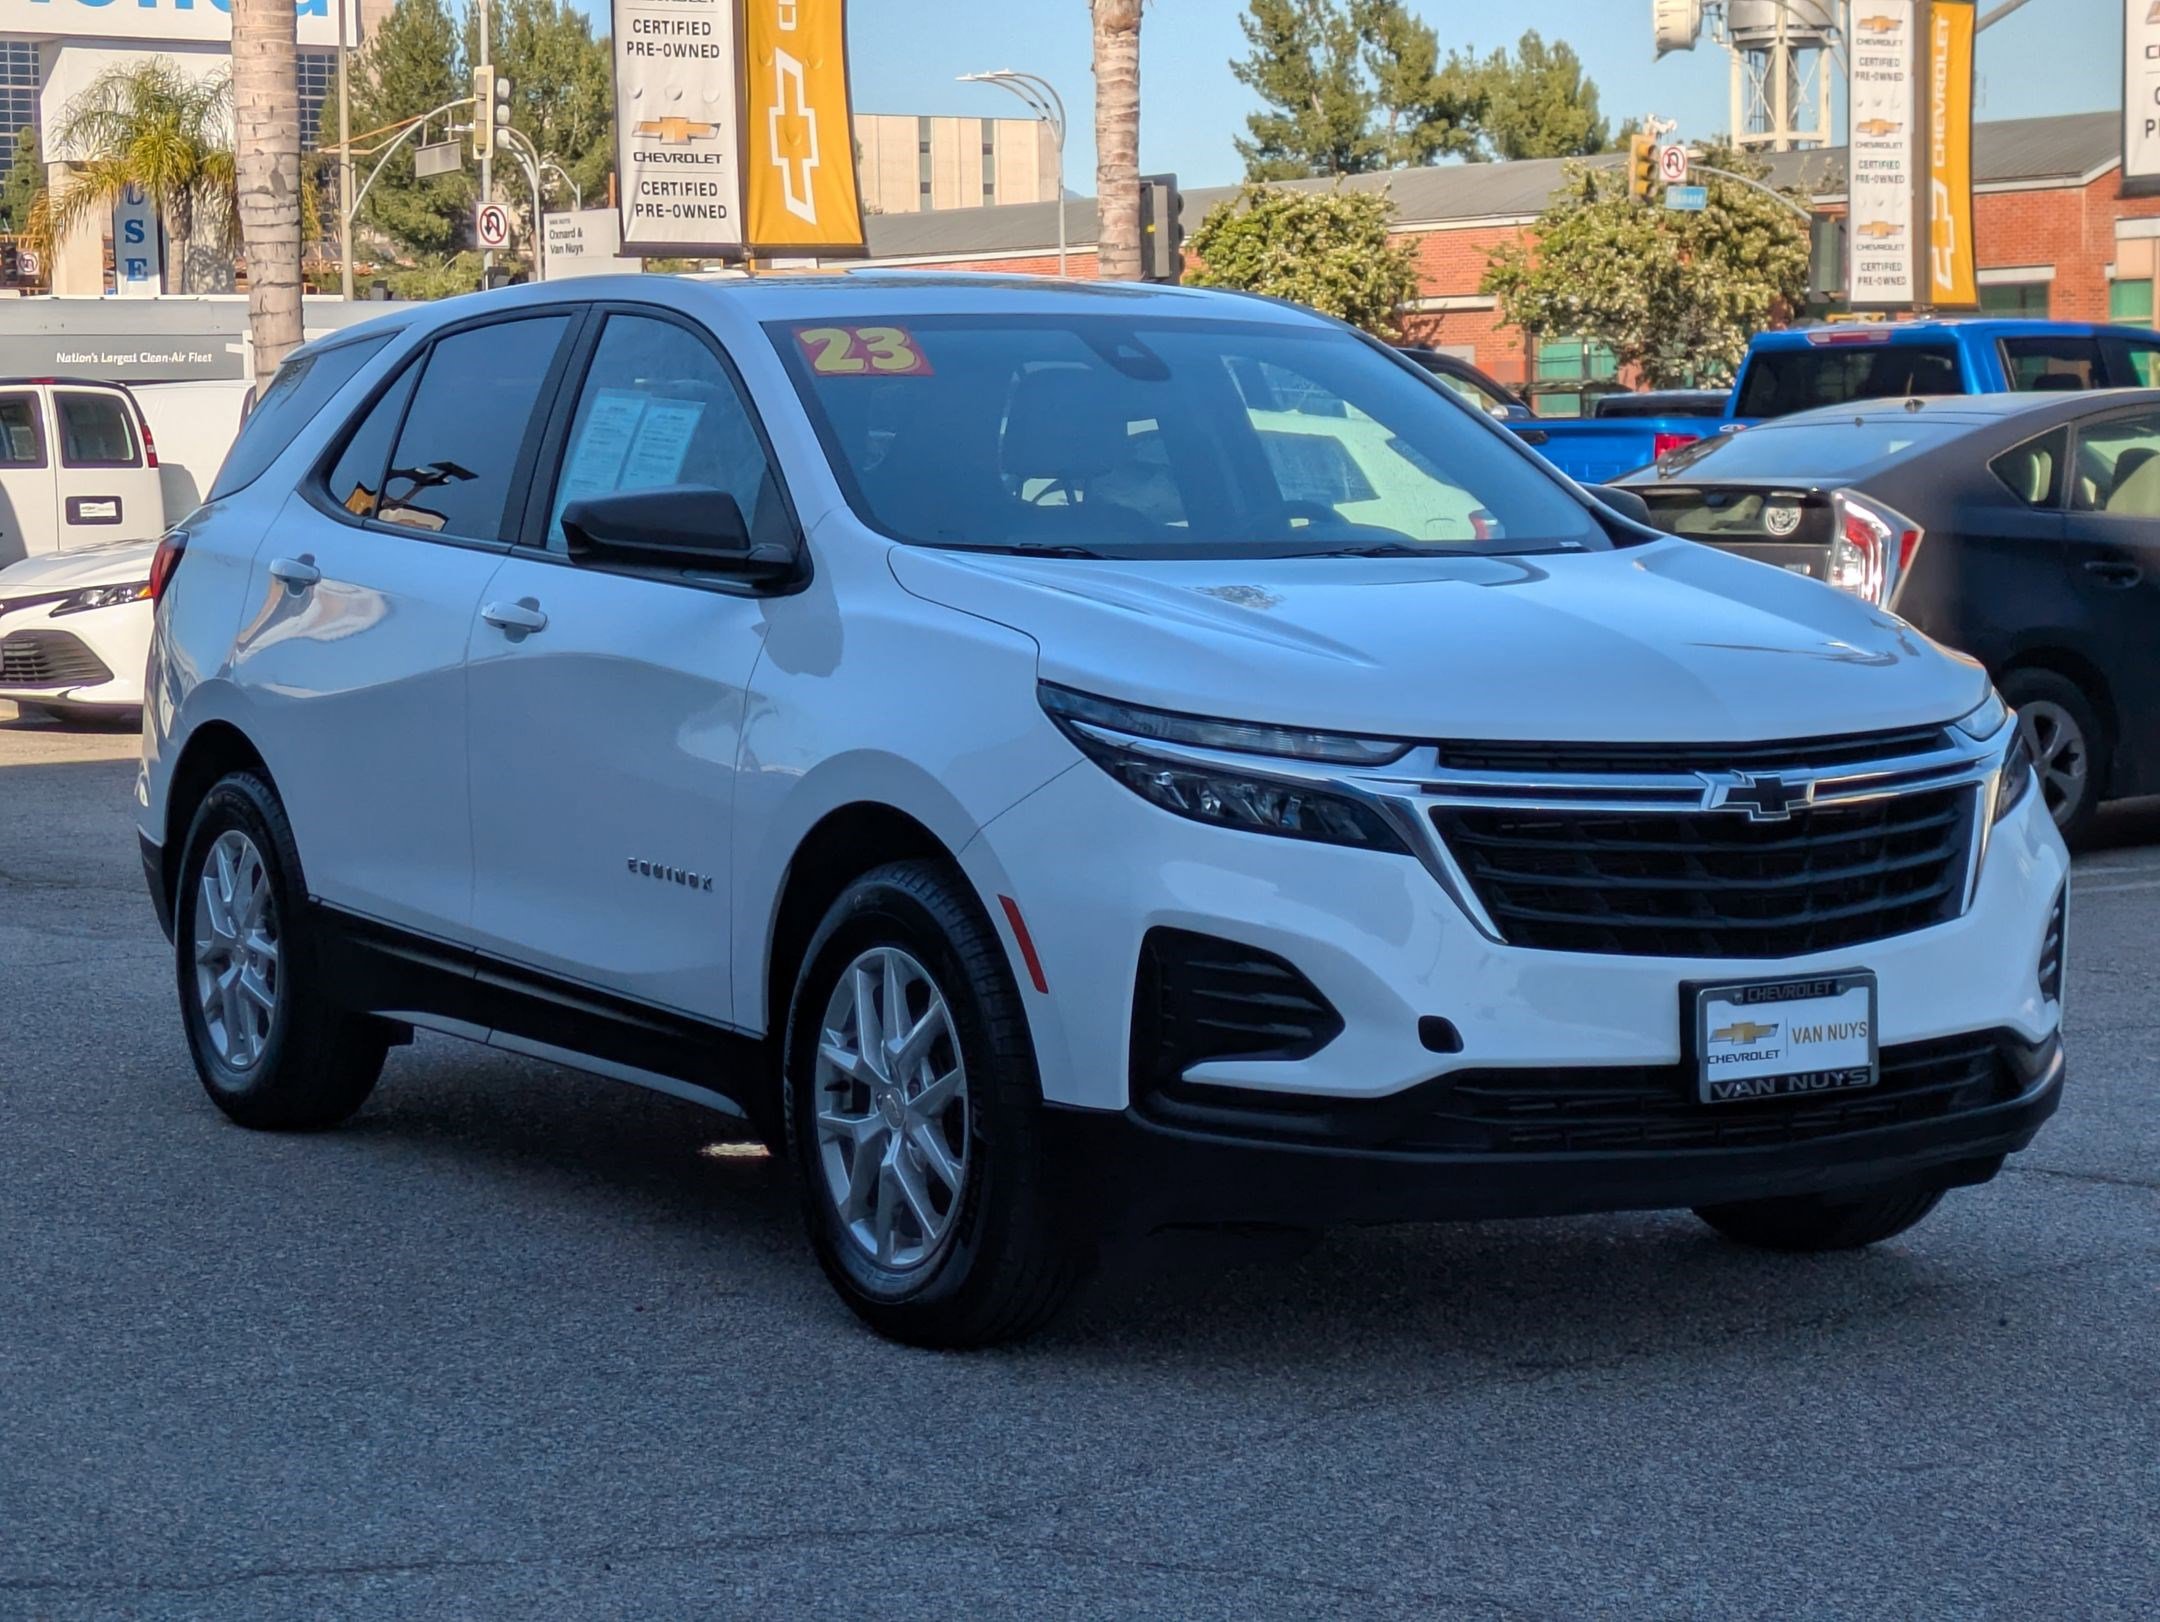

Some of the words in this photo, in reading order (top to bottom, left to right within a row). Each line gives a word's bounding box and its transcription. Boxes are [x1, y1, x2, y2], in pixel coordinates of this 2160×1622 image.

[632, 19, 712, 36] CERTIFIED
[626, 41, 720, 59] PRE-OWNED
[1856, 38, 1903, 47] CHEVROLET
[1859, 57, 1900, 67] CERTIFIED
[1855, 71, 1904, 82] PRE-OWNED
[1933, 16, 1950, 168] CHEVROLET
[1855, 141, 1903, 149] CHEVROLET
[633, 151, 723, 164] CHEVROLET
[1859, 160, 1901, 170] CERTIFIED
[1855, 174, 1905, 184] PRE-OWNED
[641, 181, 718, 197] CERTIFIED
[635, 203, 728, 219] PRE-OWNED
[549, 227, 576, 240] Oxnard
[577, 227, 583, 238] &
[550, 245, 564, 255] Van
[565, 243, 584, 256] Nuys
[1861, 262, 1902, 272] CERTIFIED
[1857, 276, 1906, 286] PRE-OWNED
[799, 327, 917, 372] 23
[56, 352, 99, 364] Nation's
[101, 352, 137, 366] Largest
[140, 351, 185, 364] Clean-Air
[188, 352, 213, 363] Fleet
[627, 857, 713, 893] EQUINOX
[1747, 980, 1832, 1002] CHEVROLET
[1792, 1026, 1823, 1045] VAN
[1827, 1021, 1868, 1042] NUYS
[1708, 1049, 1781, 1065] CHEVROLET
[1713, 1078, 1776, 1098] VAN
[1787, 1067, 1869, 1092] NUYS
